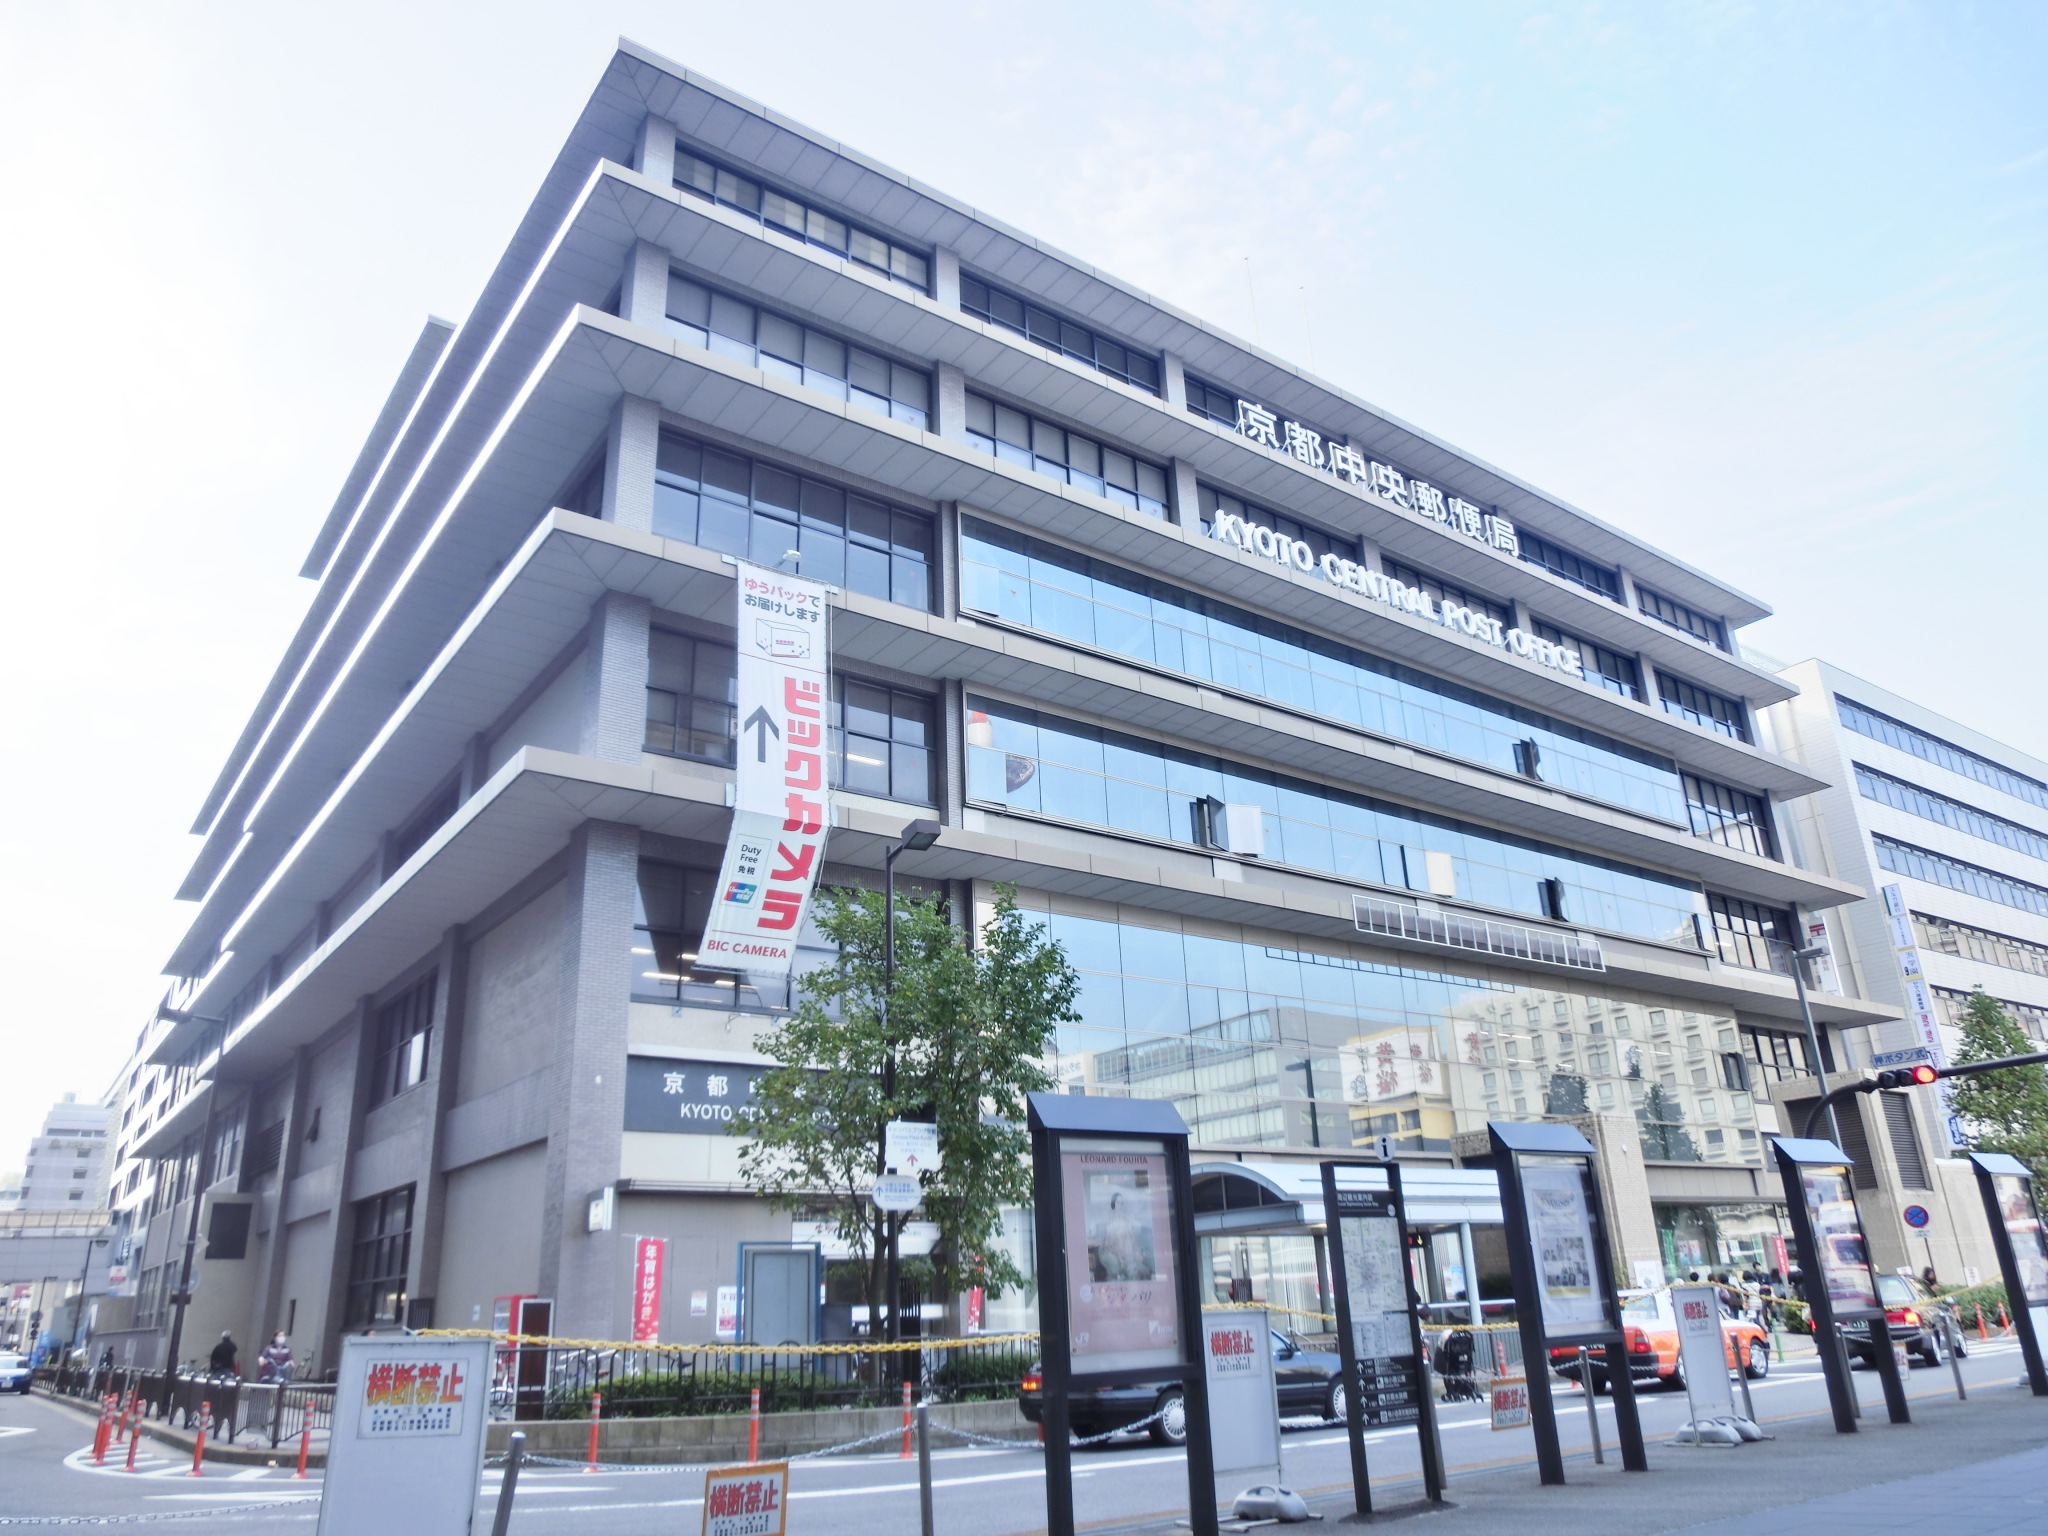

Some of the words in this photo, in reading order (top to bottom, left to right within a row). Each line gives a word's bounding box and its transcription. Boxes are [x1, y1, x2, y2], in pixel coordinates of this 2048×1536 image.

[1240, 400, 1521, 558] 京都中央郵便局
[744, 577, 821, 608] ゆうパックで
[1214, 509, 1314, 572] KYOTO
[1321, 553, 1439, 622] CENTRAL
[1441, 599, 1503, 647] POST
[1508, 628, 1584, 678] OFFICE
[744, 594, 821, 622] お届けします
[756, 676, 822, 931] ビックカメラ
[740, 853, 758, 863] Free
[741, 844, 762, 856] Duty
[707, 940, 730, 952] BIC
[732, 943, 787, 959] CAMERA
[1874, 1049, 1926, 1065] 押ボタン式
[680, 1103, 732, 1121] KYOTO
[641, 1244, 657, 1320] 年賀はがき
[1211, 1329, 1254, 1356] 横断禁止
[367, 1363, 464, 1407] 横断禁止
[710, 1479, 778, 1519] 横断禁止
